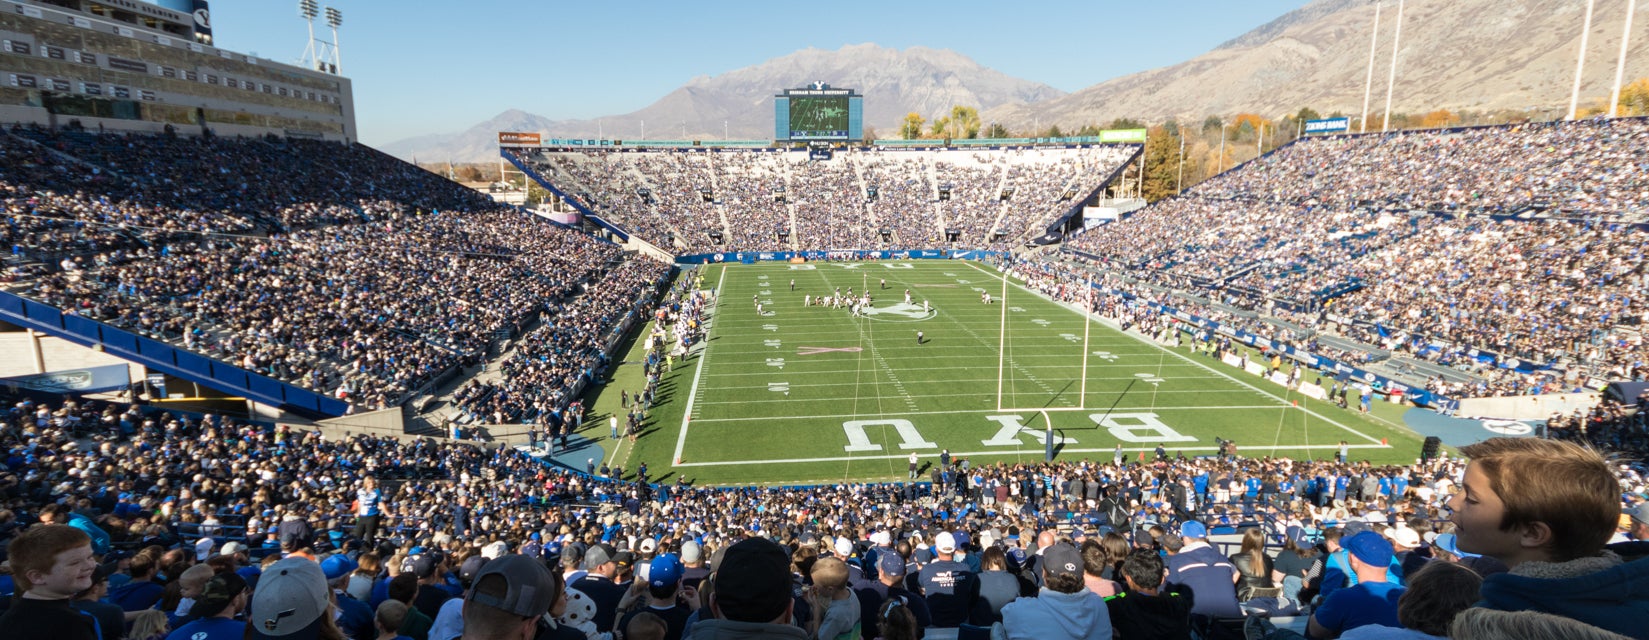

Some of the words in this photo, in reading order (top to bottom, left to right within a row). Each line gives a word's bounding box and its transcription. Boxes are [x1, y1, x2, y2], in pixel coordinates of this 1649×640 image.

[141, 5, 180, 20] STADIUM
[814, 80, 825, 90] Y
[1306, 122, 1326, 130] ZIONS
[1327, 120, 1347, 129] BANK
